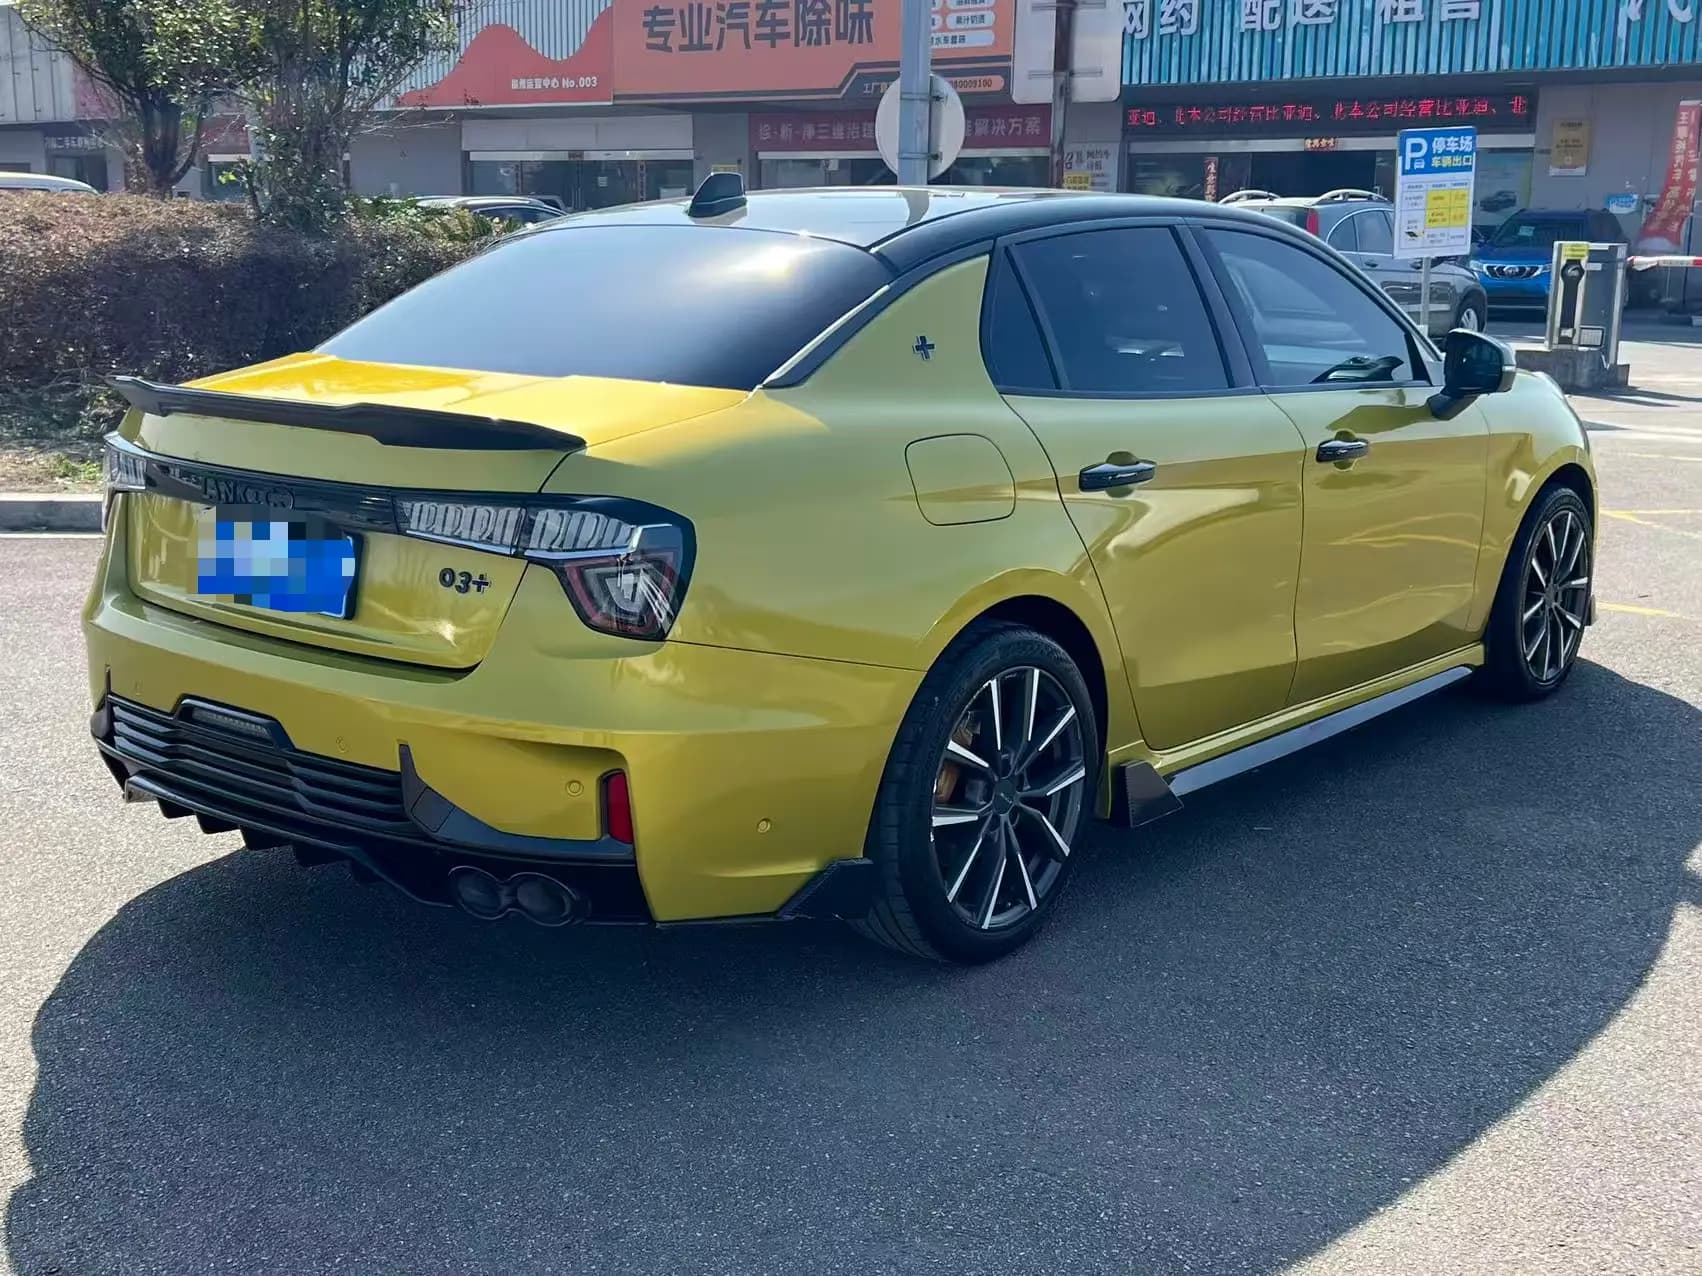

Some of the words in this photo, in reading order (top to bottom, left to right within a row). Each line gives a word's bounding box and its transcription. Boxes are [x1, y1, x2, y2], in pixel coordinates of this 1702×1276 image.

[642, 0, 874, 53] 专业汽车除味
[562, 77, 598, 89] No.003
[1405, 138, 1428, 170] P
[1432, 136, 1473, 154] 停车场
[1431, 155, 1473, 168] 车辆出口
[439, 567, 492, 594] 03+
